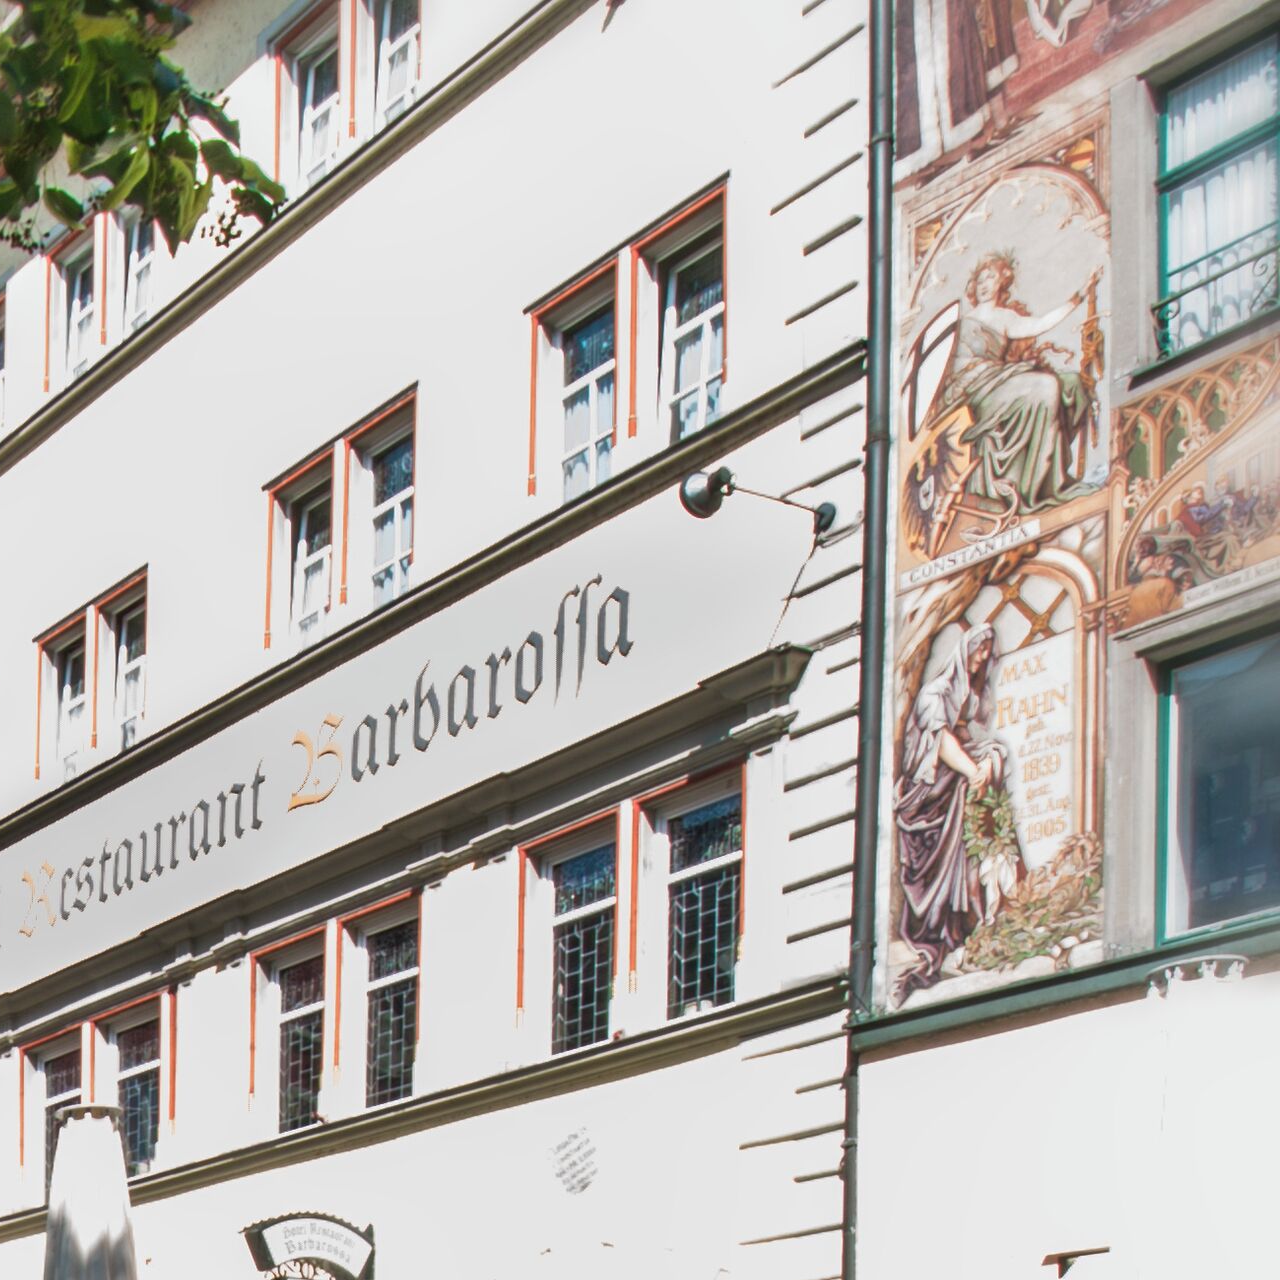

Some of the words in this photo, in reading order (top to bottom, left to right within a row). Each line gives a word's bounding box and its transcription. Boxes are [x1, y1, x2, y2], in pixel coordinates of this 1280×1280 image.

[909, 526, 1028, 584] CONSTANTIA
[997, 651, 1048, 687] MAX
[995, 683, 1070, 730] RAHN
[18, 756, 266, 938] Restaurant
